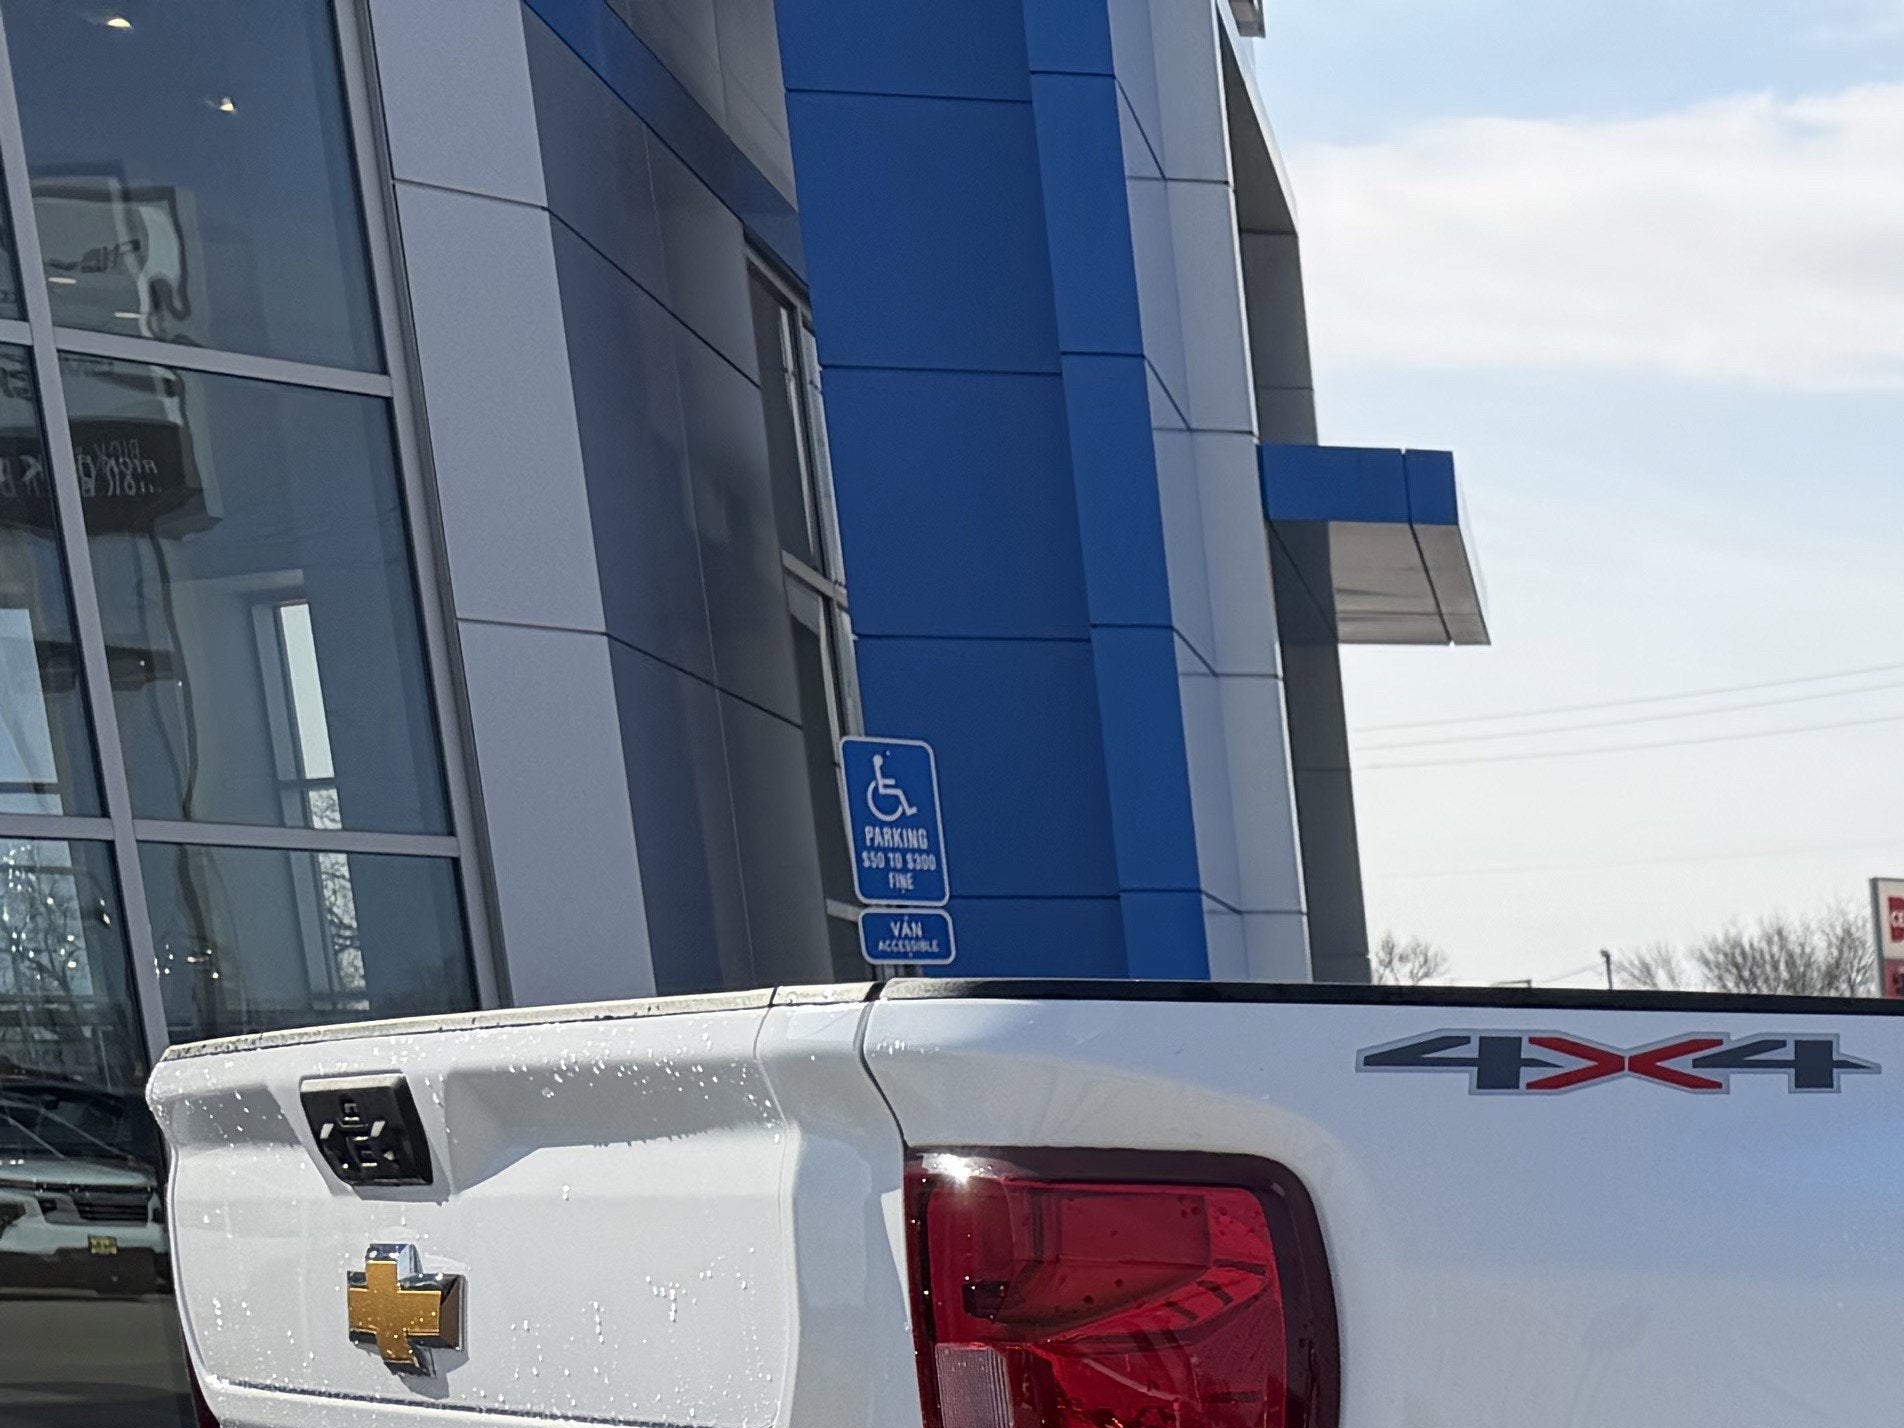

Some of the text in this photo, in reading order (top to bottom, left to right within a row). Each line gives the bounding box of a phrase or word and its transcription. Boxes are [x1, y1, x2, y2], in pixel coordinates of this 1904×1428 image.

[865, 826, 928, 850] PARKING
[862, 851, 886, 869] $50
[888, 852, 904, 869] TO
[888, 872, 915, 890] FINE
[890, 921, 923, 938] VAN
[878, 939, 940, 953] ACCESSIBLE
